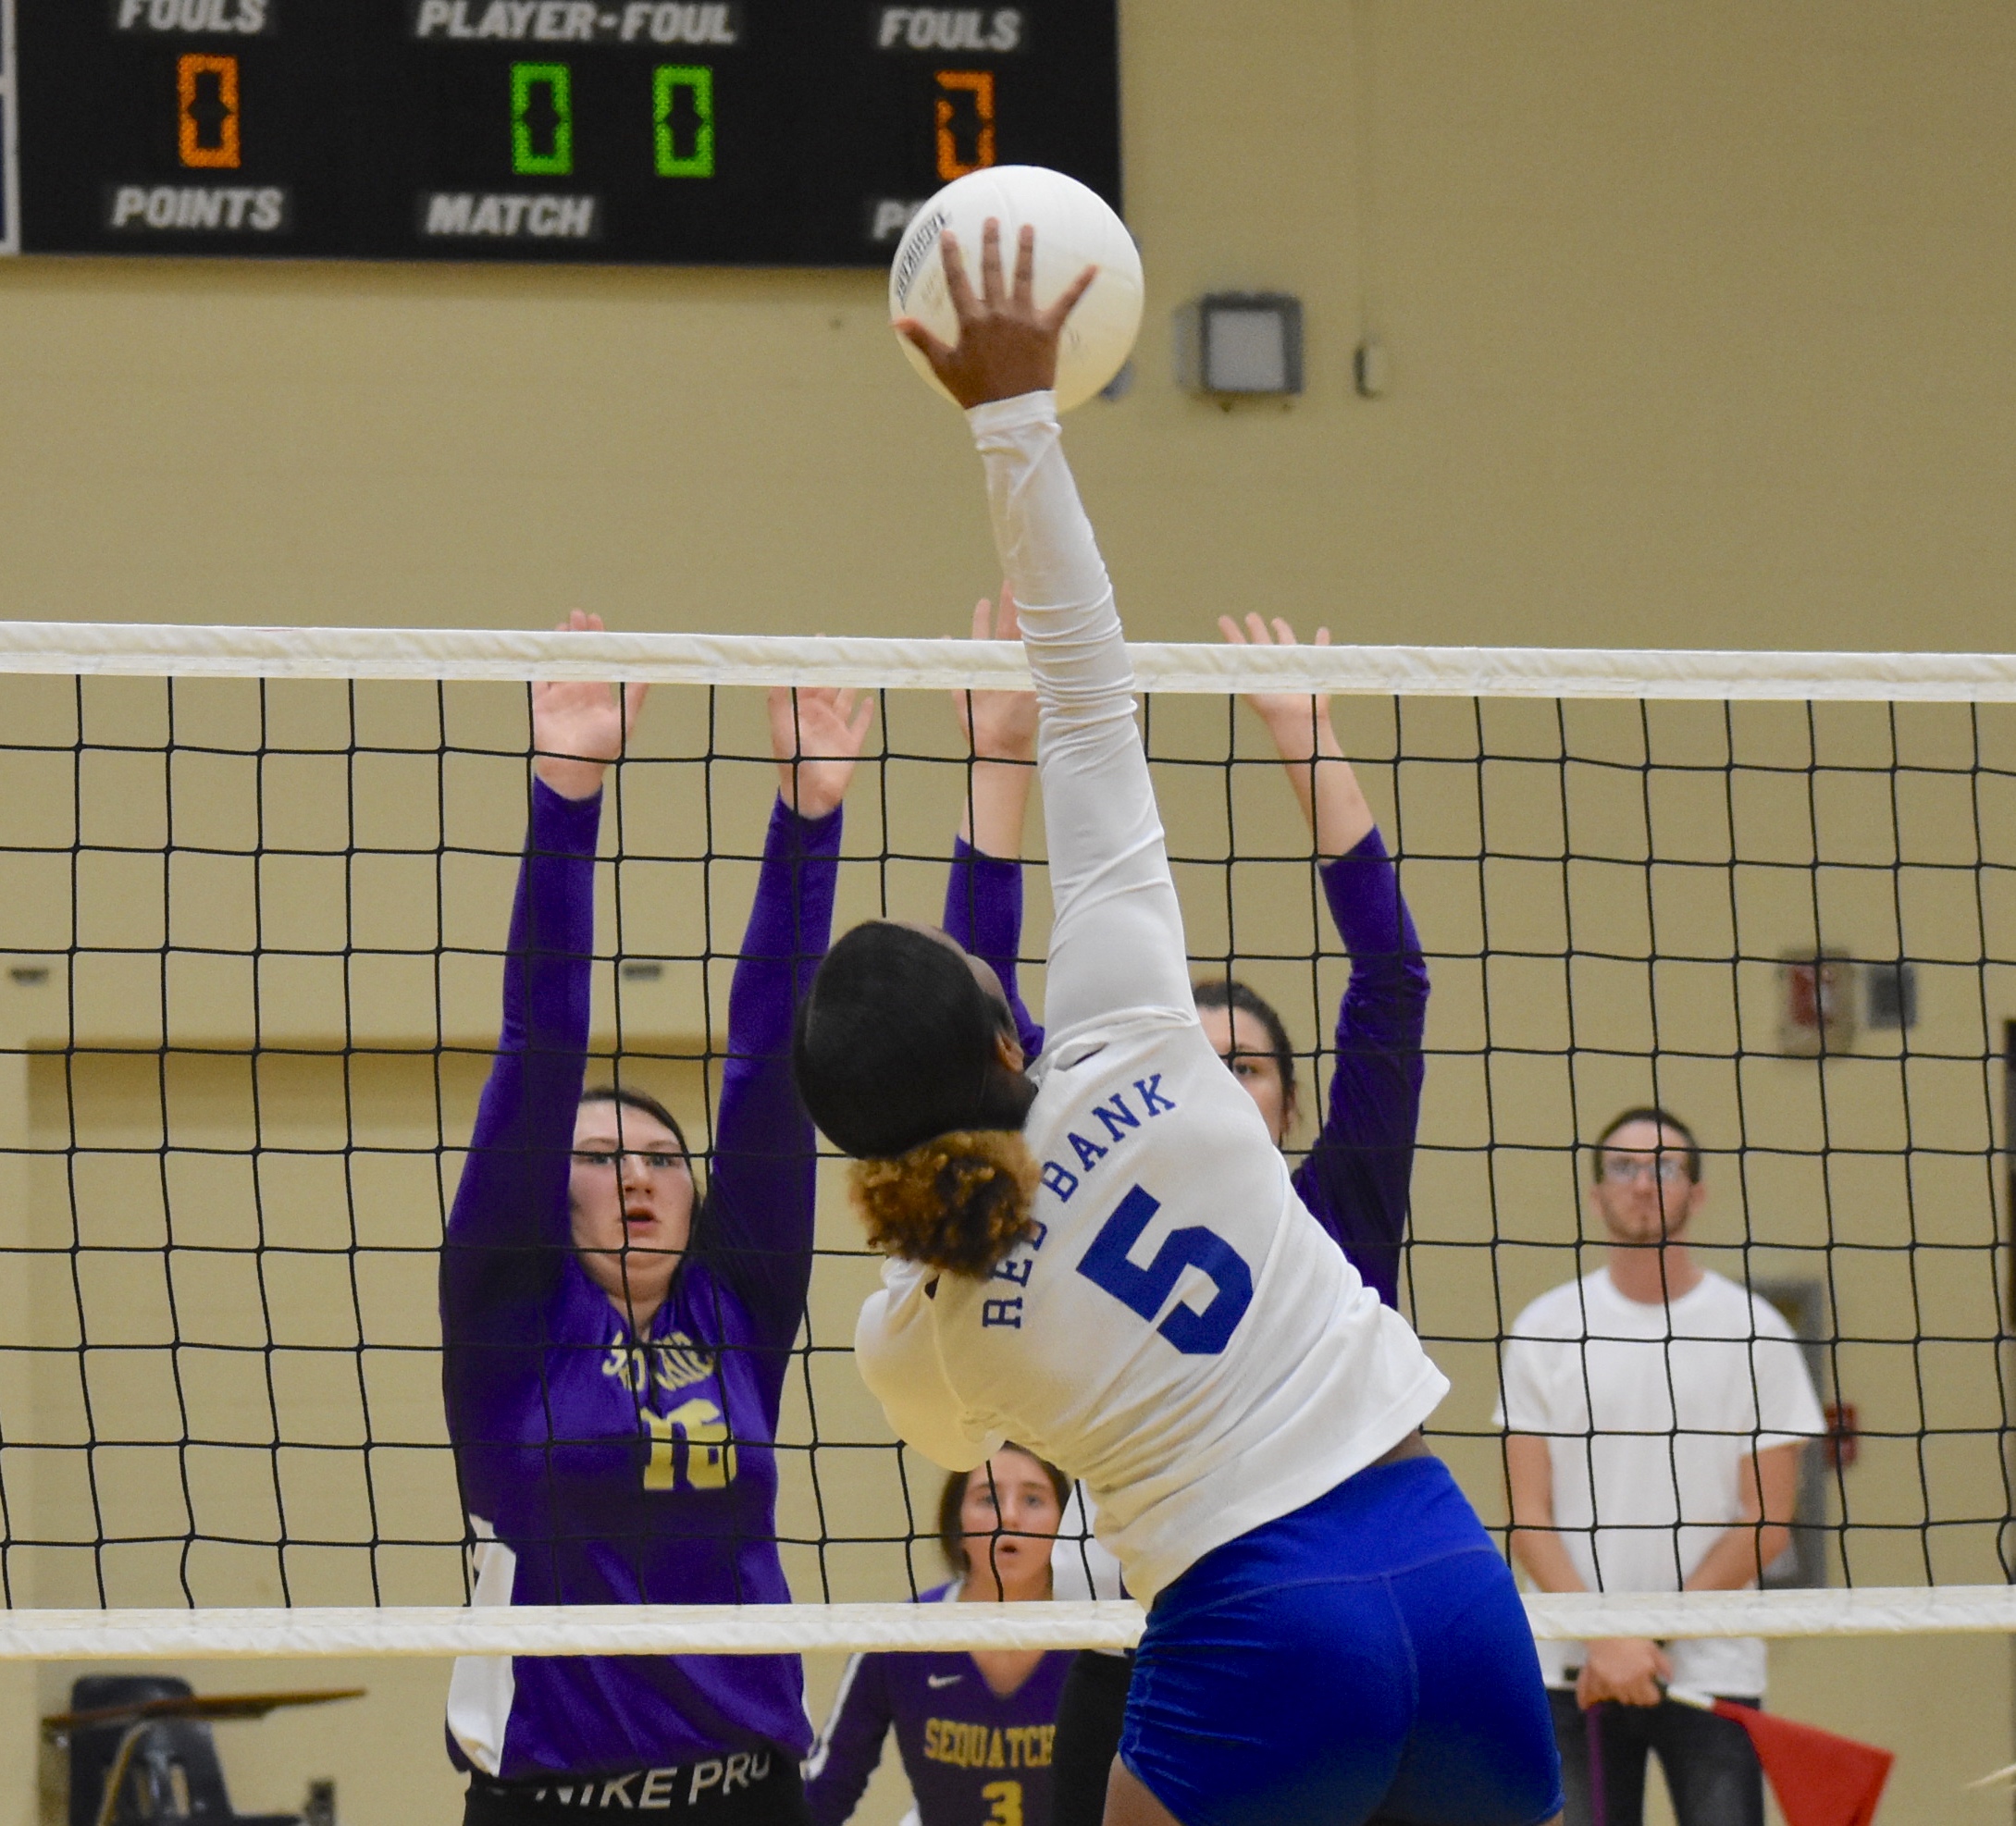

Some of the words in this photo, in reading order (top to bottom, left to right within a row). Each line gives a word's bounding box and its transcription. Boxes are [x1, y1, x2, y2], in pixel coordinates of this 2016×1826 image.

[118, 0, 266, 34] FOULS
[417, 1, 736, 44] PLAYER-FOUL
[878, 7, 1020, 52] FOULS
[177, 53, 241, 168] 0
[112, 187, 283, 229] POINTS
[425, 194, 594, 237] MATCH
[1041, 1073, 1176, 1203] BANK
[1075, 1182, 1254, 1355] 5
